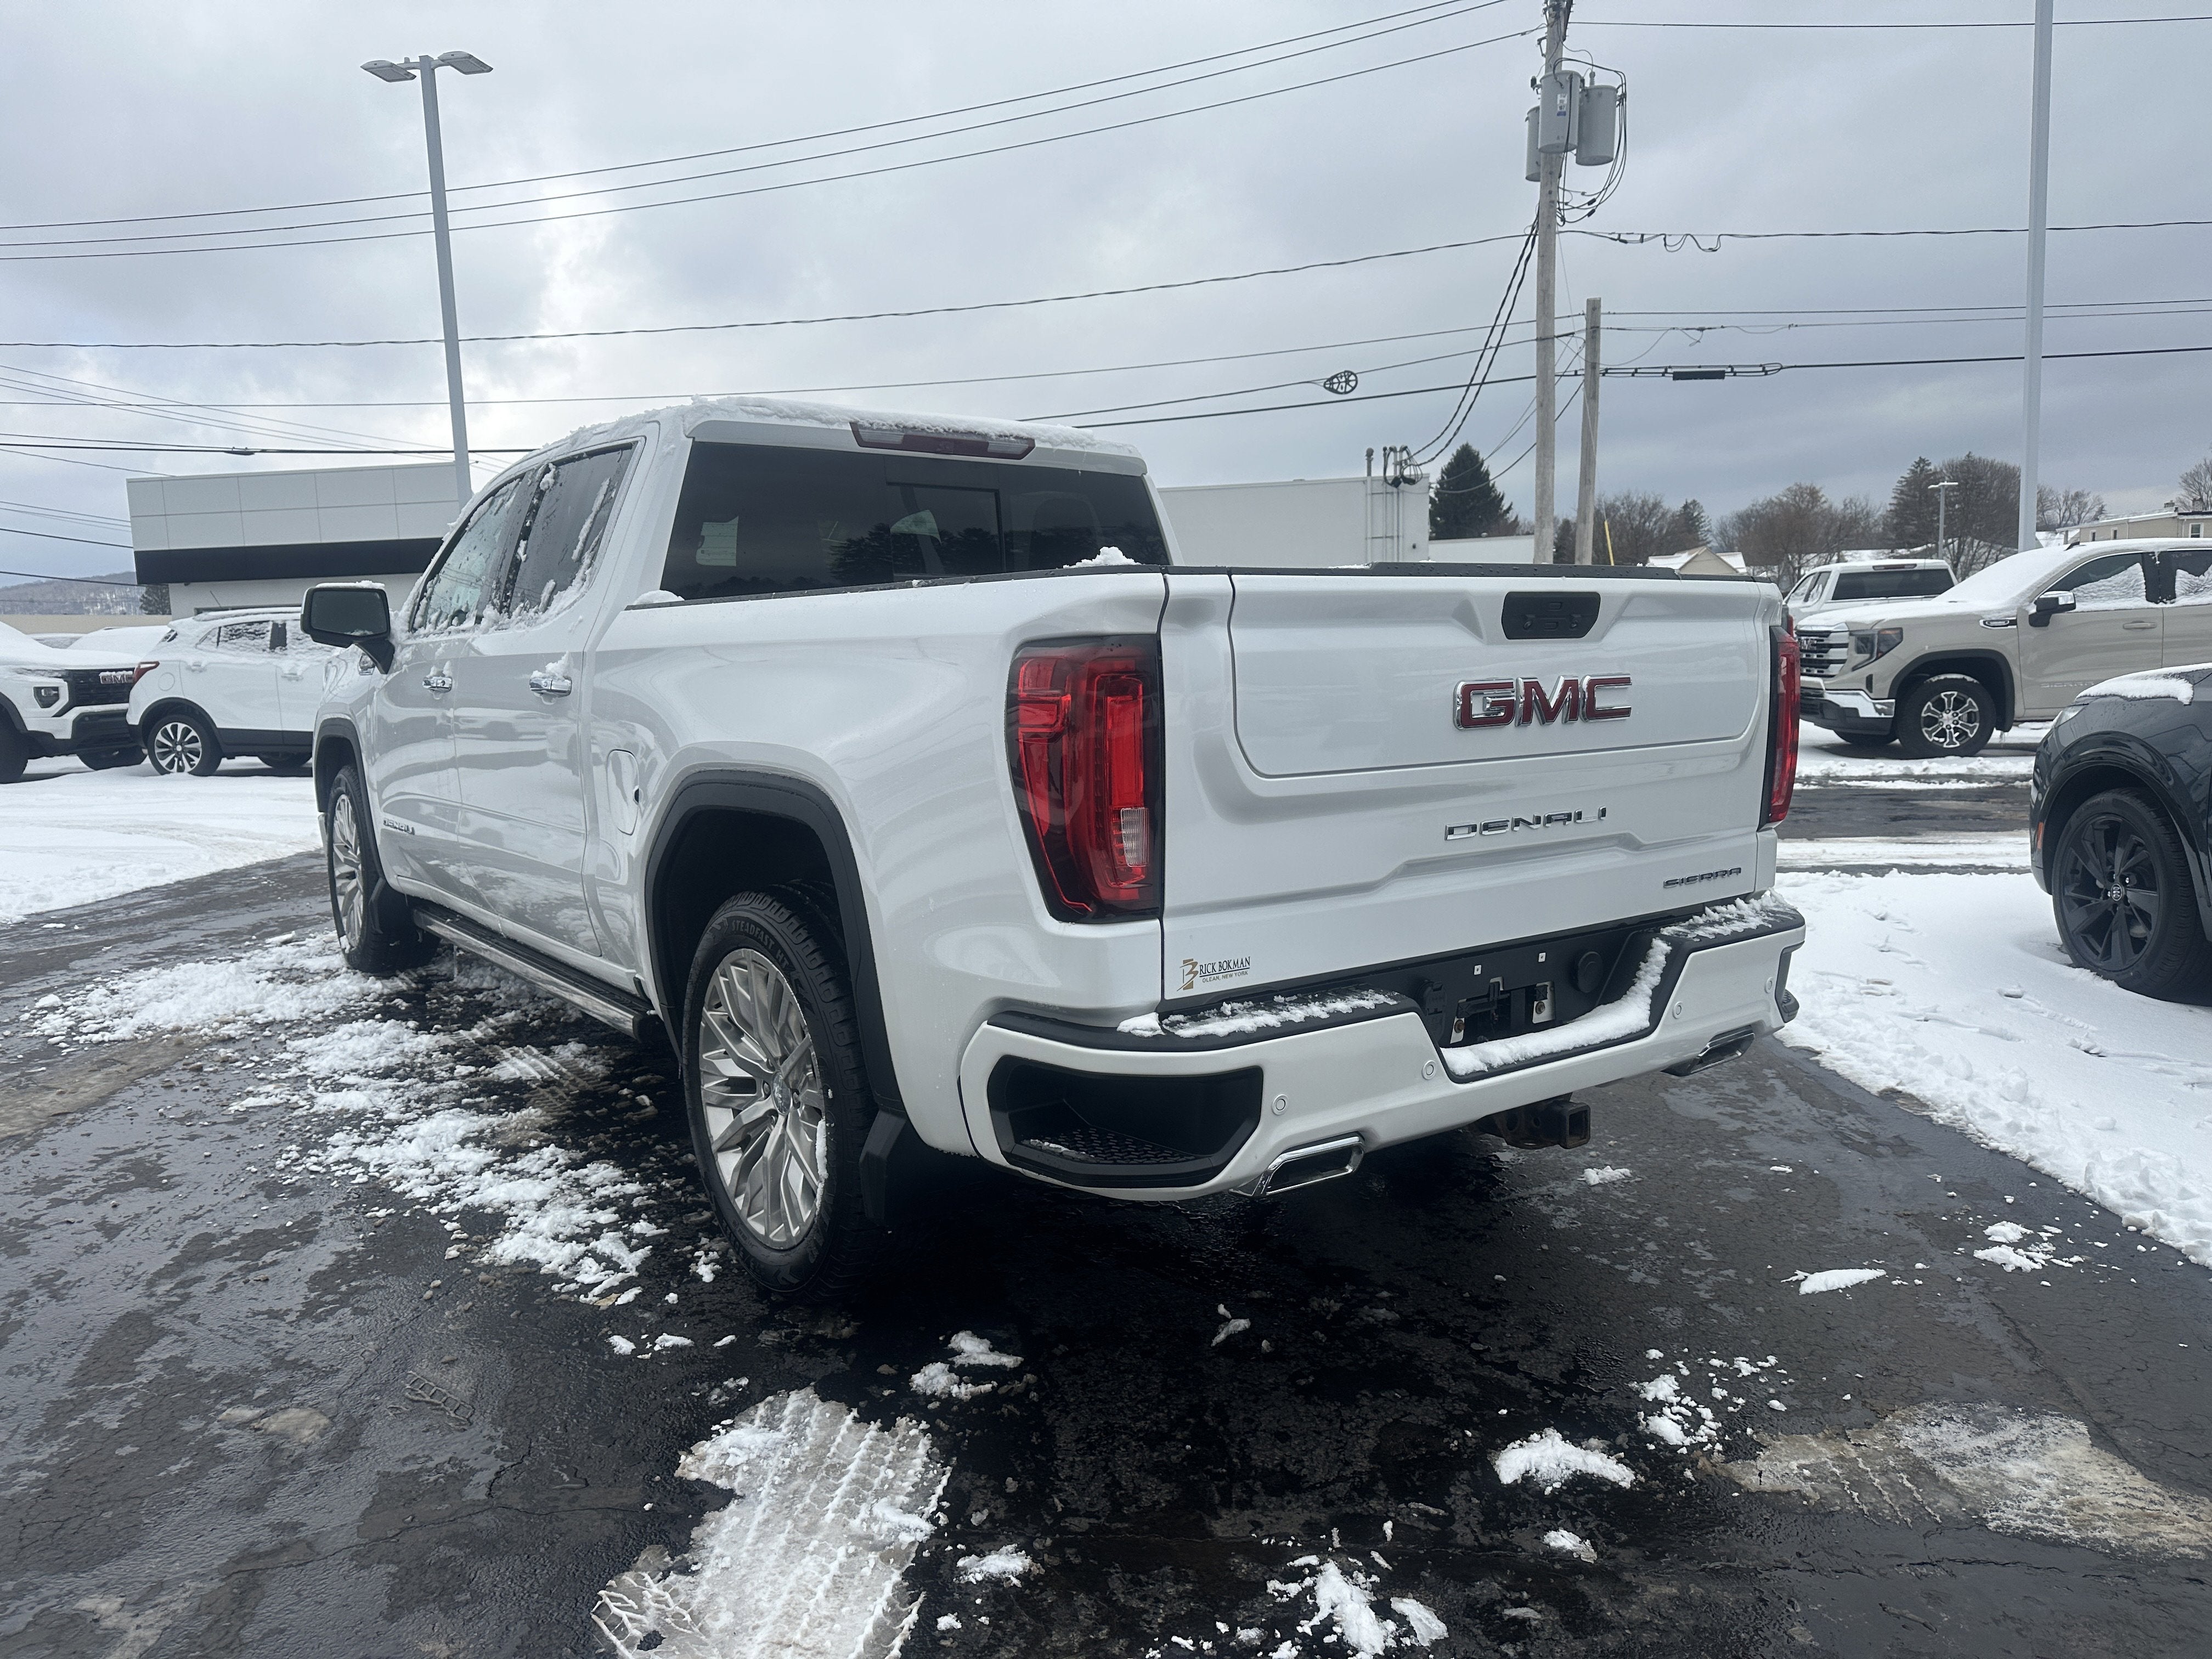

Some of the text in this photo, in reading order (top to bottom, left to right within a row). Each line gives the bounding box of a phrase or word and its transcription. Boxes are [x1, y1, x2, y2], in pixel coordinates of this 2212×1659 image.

[1453, 673, 1633, 730] GMC
[1444, 805, 1607, 841] DENALI
[1663, 867, 1742, 888] SIERRA
[732, 919, 789, 969] STEADFAST HT
[1199, 956, 1251, 975] RICK BOKMAN
